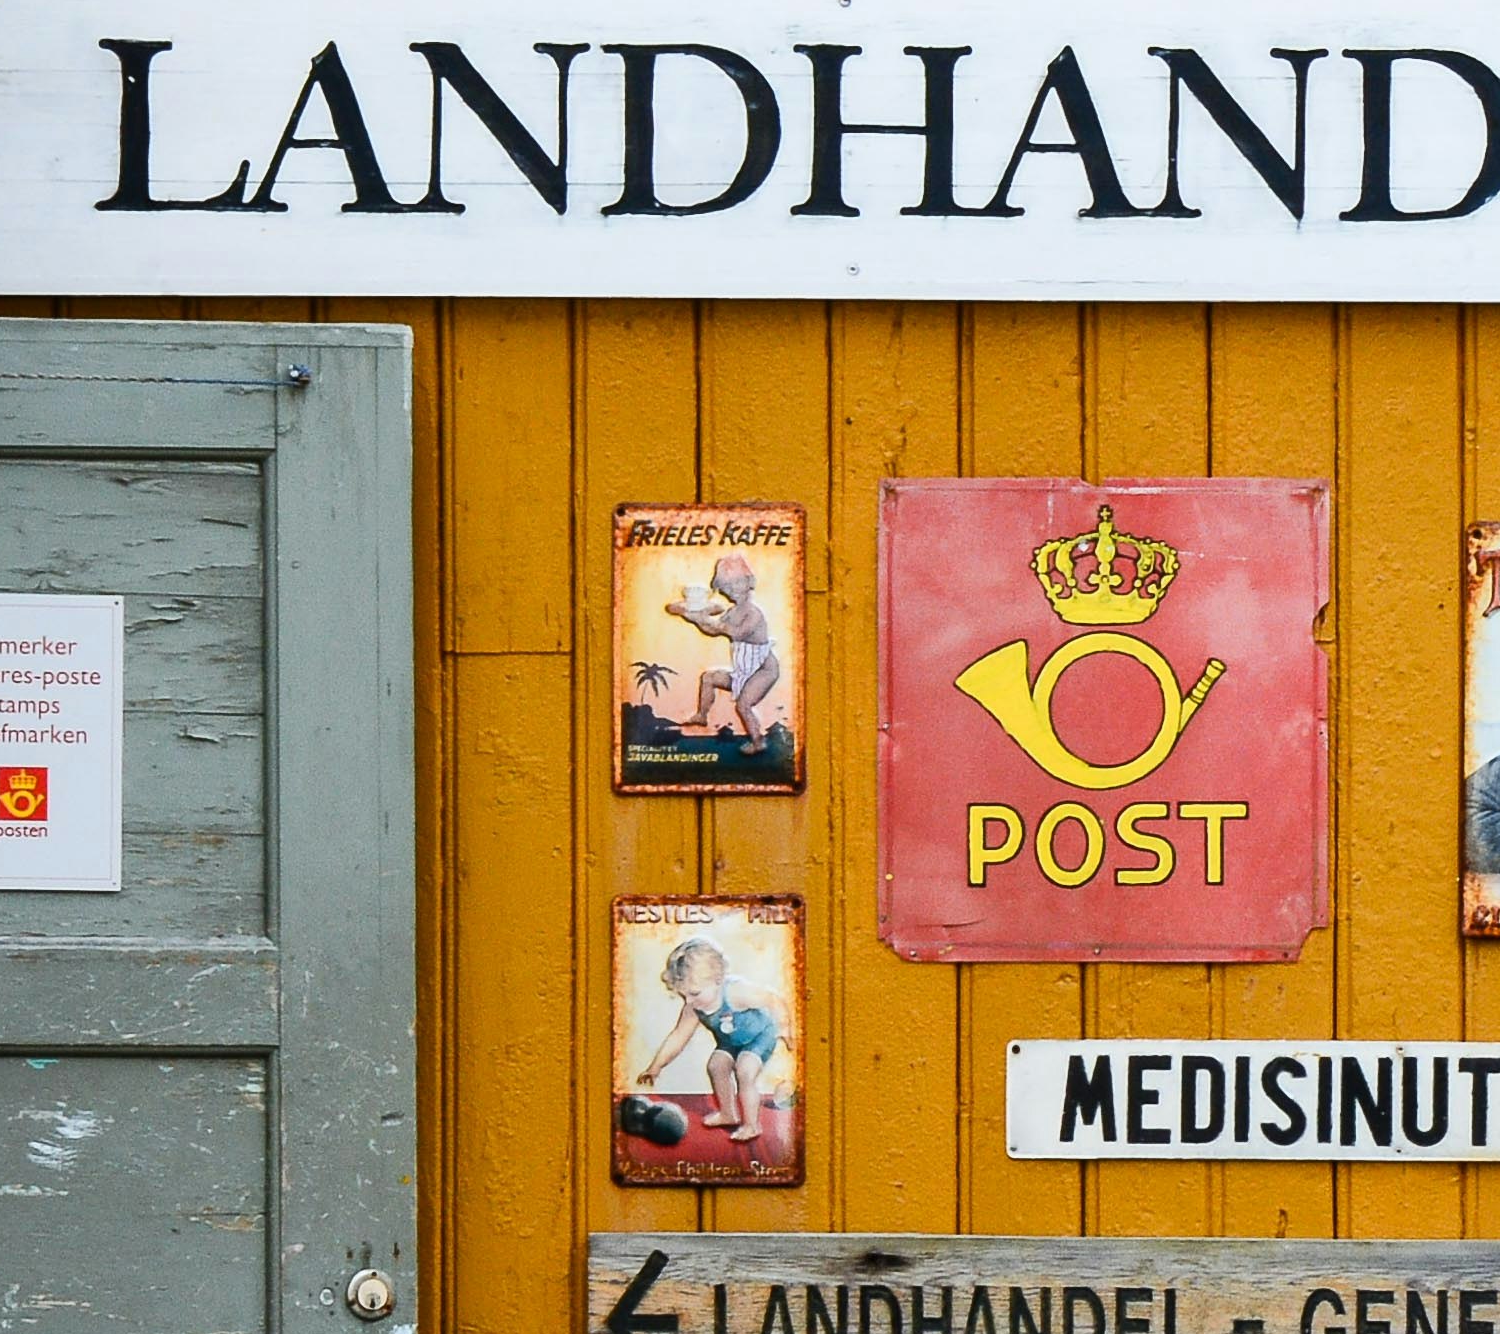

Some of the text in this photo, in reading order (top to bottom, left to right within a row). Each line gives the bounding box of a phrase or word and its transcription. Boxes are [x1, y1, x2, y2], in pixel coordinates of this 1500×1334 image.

[624, 519, 793, 548] FRIELES KAFFE
[967, 800, 1250, 889] POST
